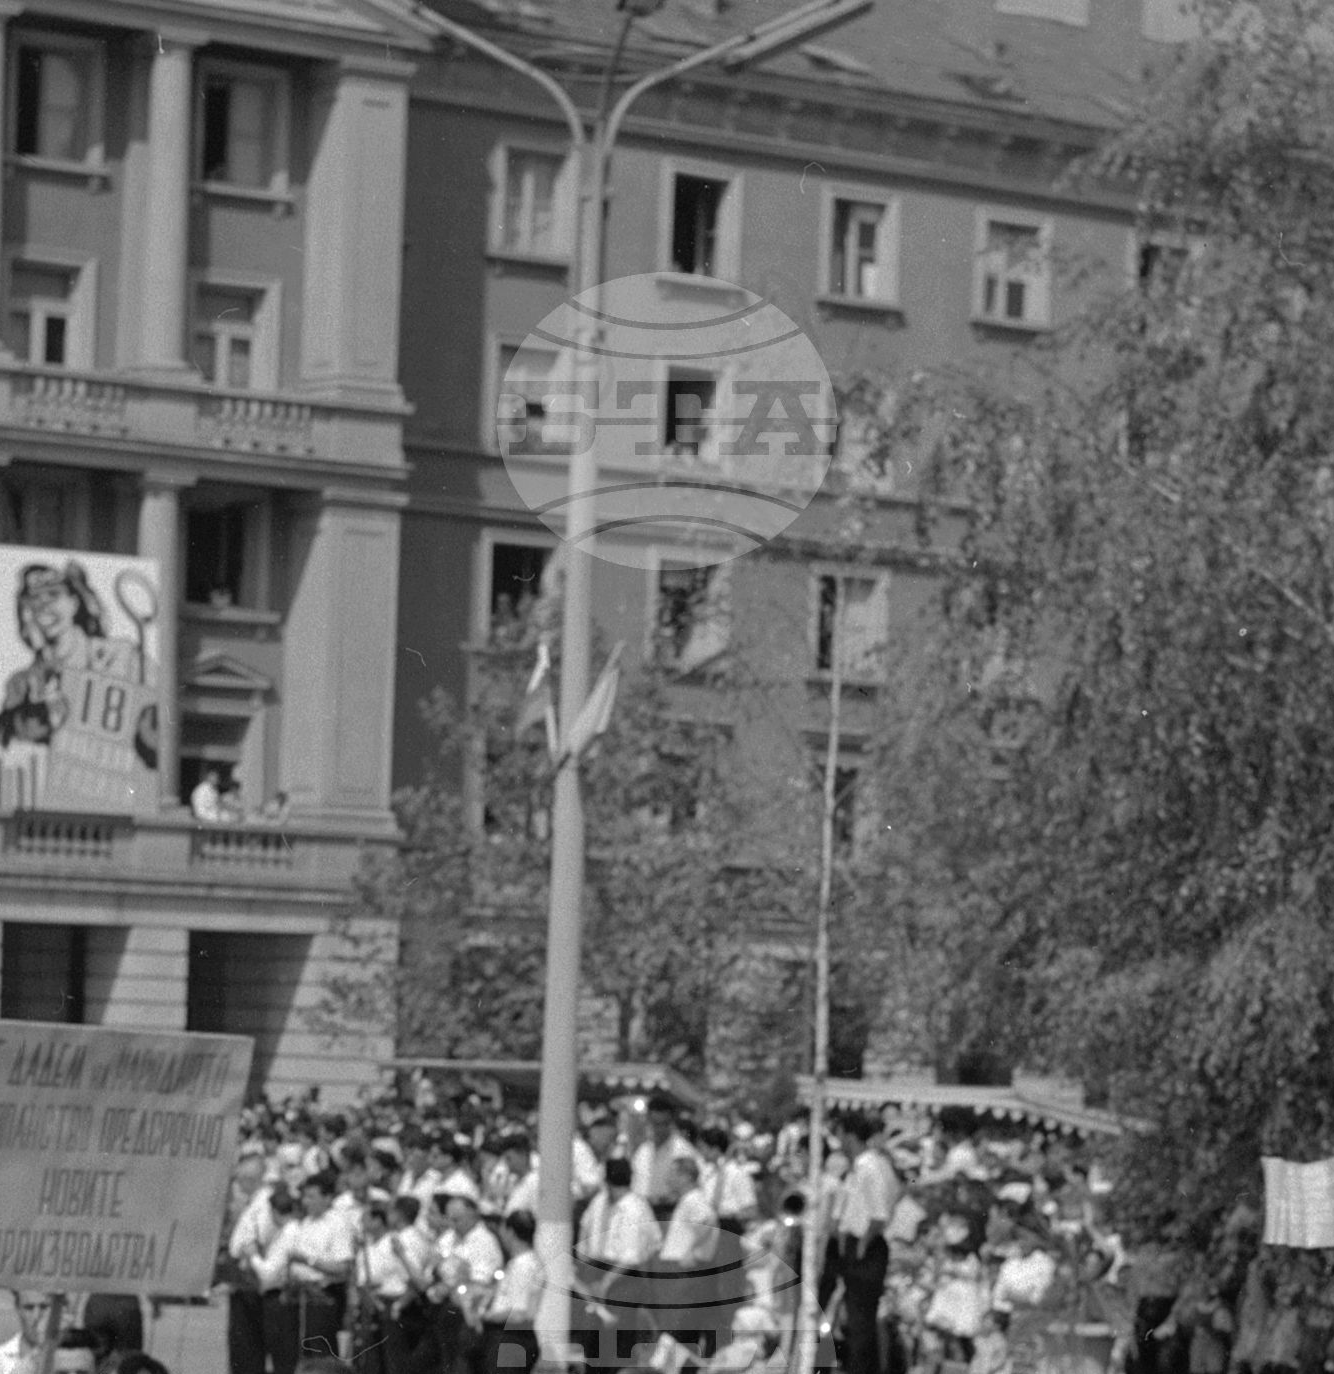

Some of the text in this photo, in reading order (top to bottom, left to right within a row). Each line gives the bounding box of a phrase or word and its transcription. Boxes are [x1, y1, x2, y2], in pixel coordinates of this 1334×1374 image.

[82, 679, 126, 733] 18
[98, 1106, 225, 1160] ПРЕДСРОЧНО
[38, 1168, 126, 1219] НОВИТЕ
